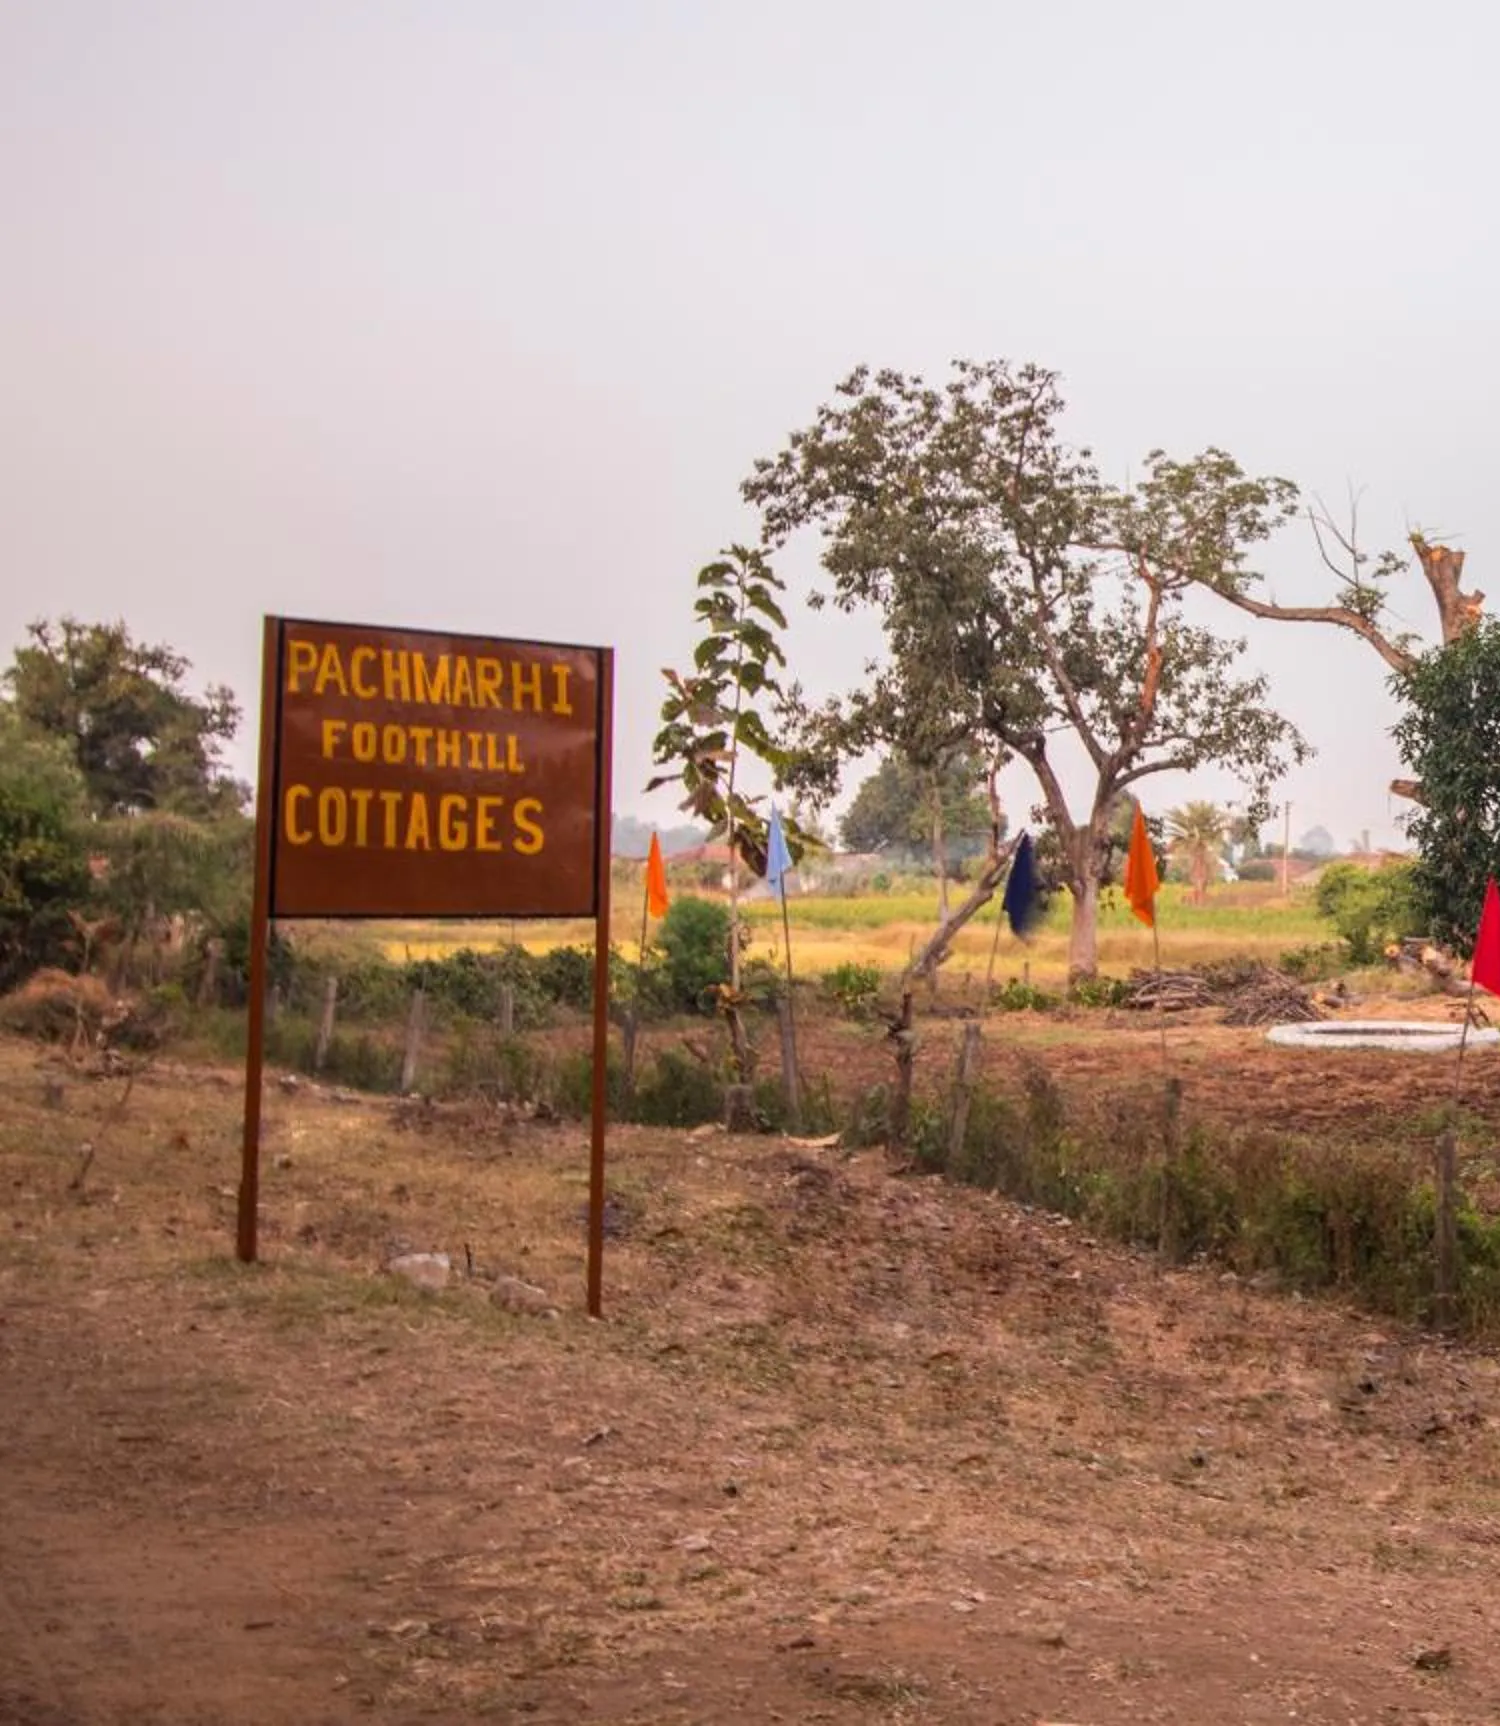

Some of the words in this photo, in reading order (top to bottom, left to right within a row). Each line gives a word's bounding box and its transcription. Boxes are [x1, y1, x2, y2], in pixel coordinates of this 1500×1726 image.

[287, 641, 573, 716] PACHMARHI
[321, 719, 525, 773] FOOTHILL
[284, 784, 546, 856] COTTAGES
